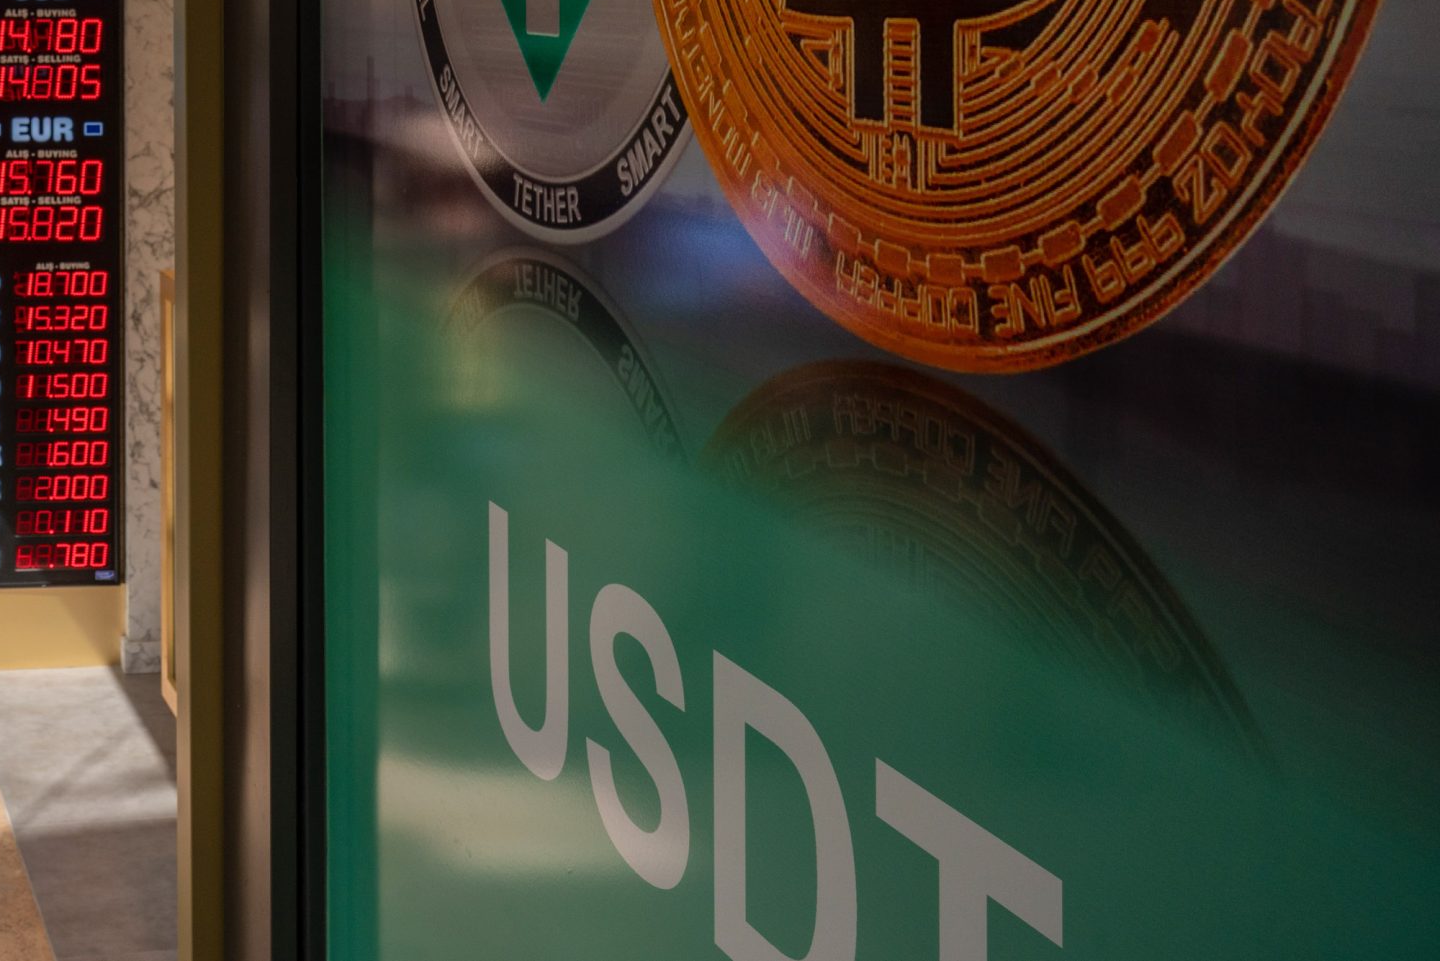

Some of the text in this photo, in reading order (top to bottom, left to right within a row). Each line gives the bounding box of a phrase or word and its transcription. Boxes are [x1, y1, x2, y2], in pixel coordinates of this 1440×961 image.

[36, 8, 77, 18] BUYING
[38, 54, 82, 64] SELLING
[11, 116, 74, 142] EUR
[37, 149, 78, 159] BUYING
[512, 173, 582, 223] TETHER
[617, 85, 684, 197] SMART
[38, 196, 82, 205] SELLING
[836, 250, 980, 335] COPPER
[988, 263, 1082, 338] FINE
[489, 500, 1063, 961] USDT
